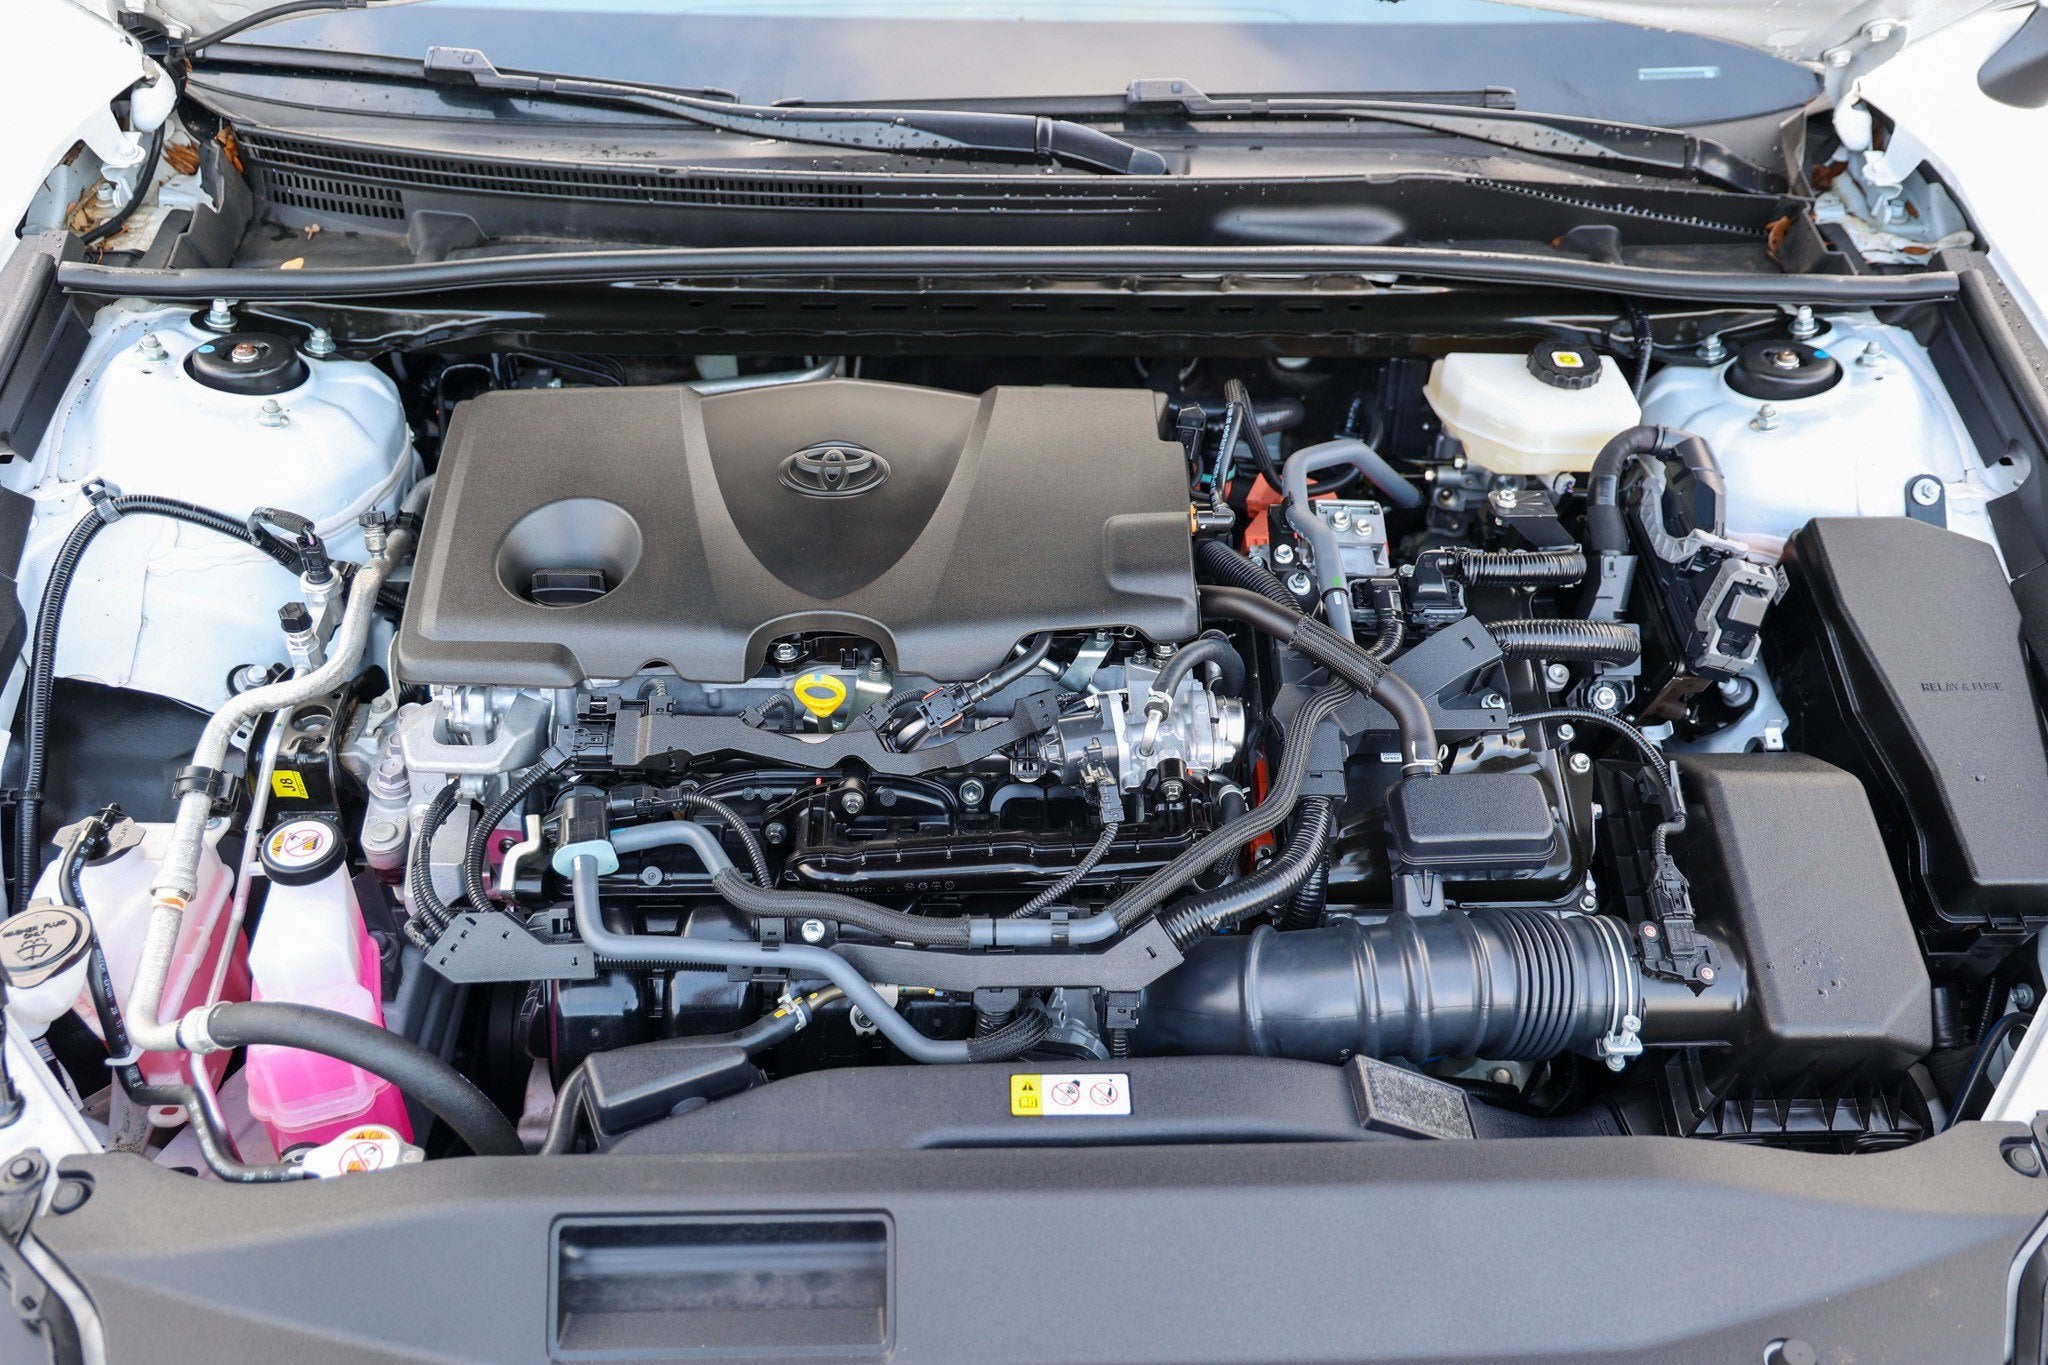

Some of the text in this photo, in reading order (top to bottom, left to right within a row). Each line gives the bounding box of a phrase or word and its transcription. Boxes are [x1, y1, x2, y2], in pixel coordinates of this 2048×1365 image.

[1921, 682, 2004, 692] RELAY & FUSE
[280, 778, 296, 792] J8
[42, 919, 68, 929] FLUID
[23, 929, 46, 940] ONLY
